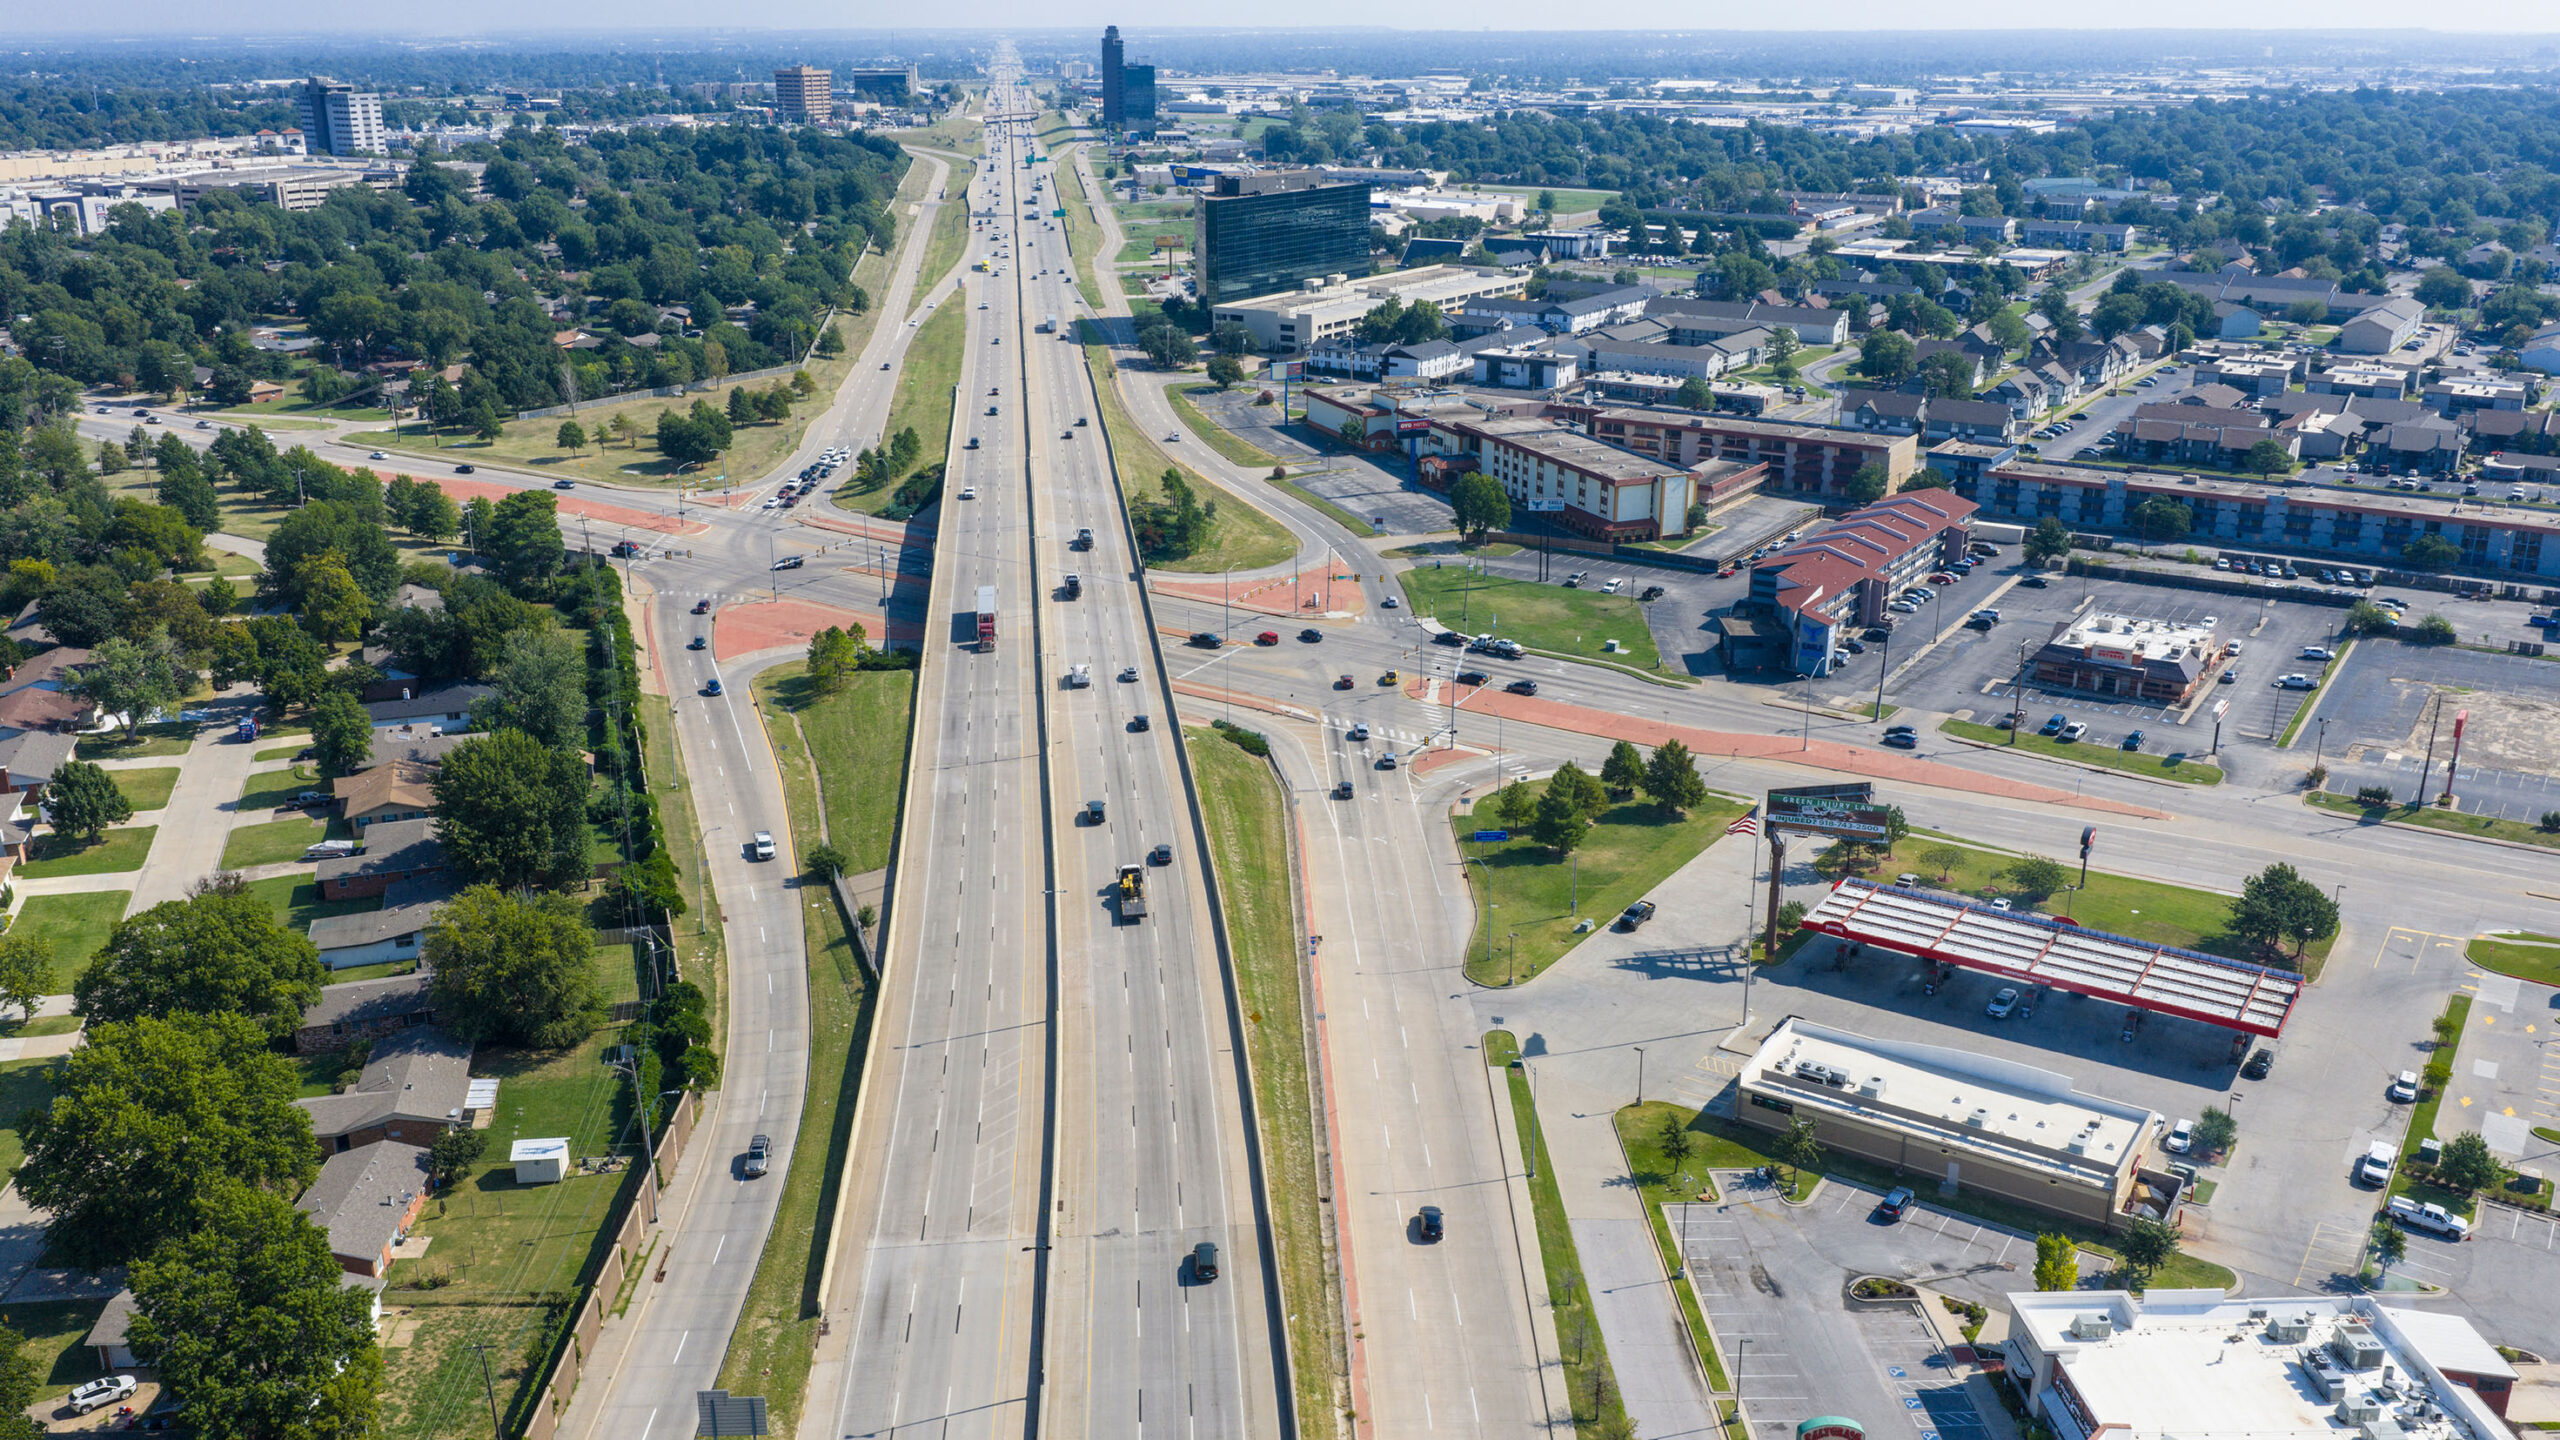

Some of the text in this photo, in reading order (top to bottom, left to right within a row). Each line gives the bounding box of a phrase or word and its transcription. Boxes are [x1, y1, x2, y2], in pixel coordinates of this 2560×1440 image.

[1782, 796, 1874, 812] GREEN INJURY LAW
[1775, 814, 1879, 832] INJURED? 918-743-2500
